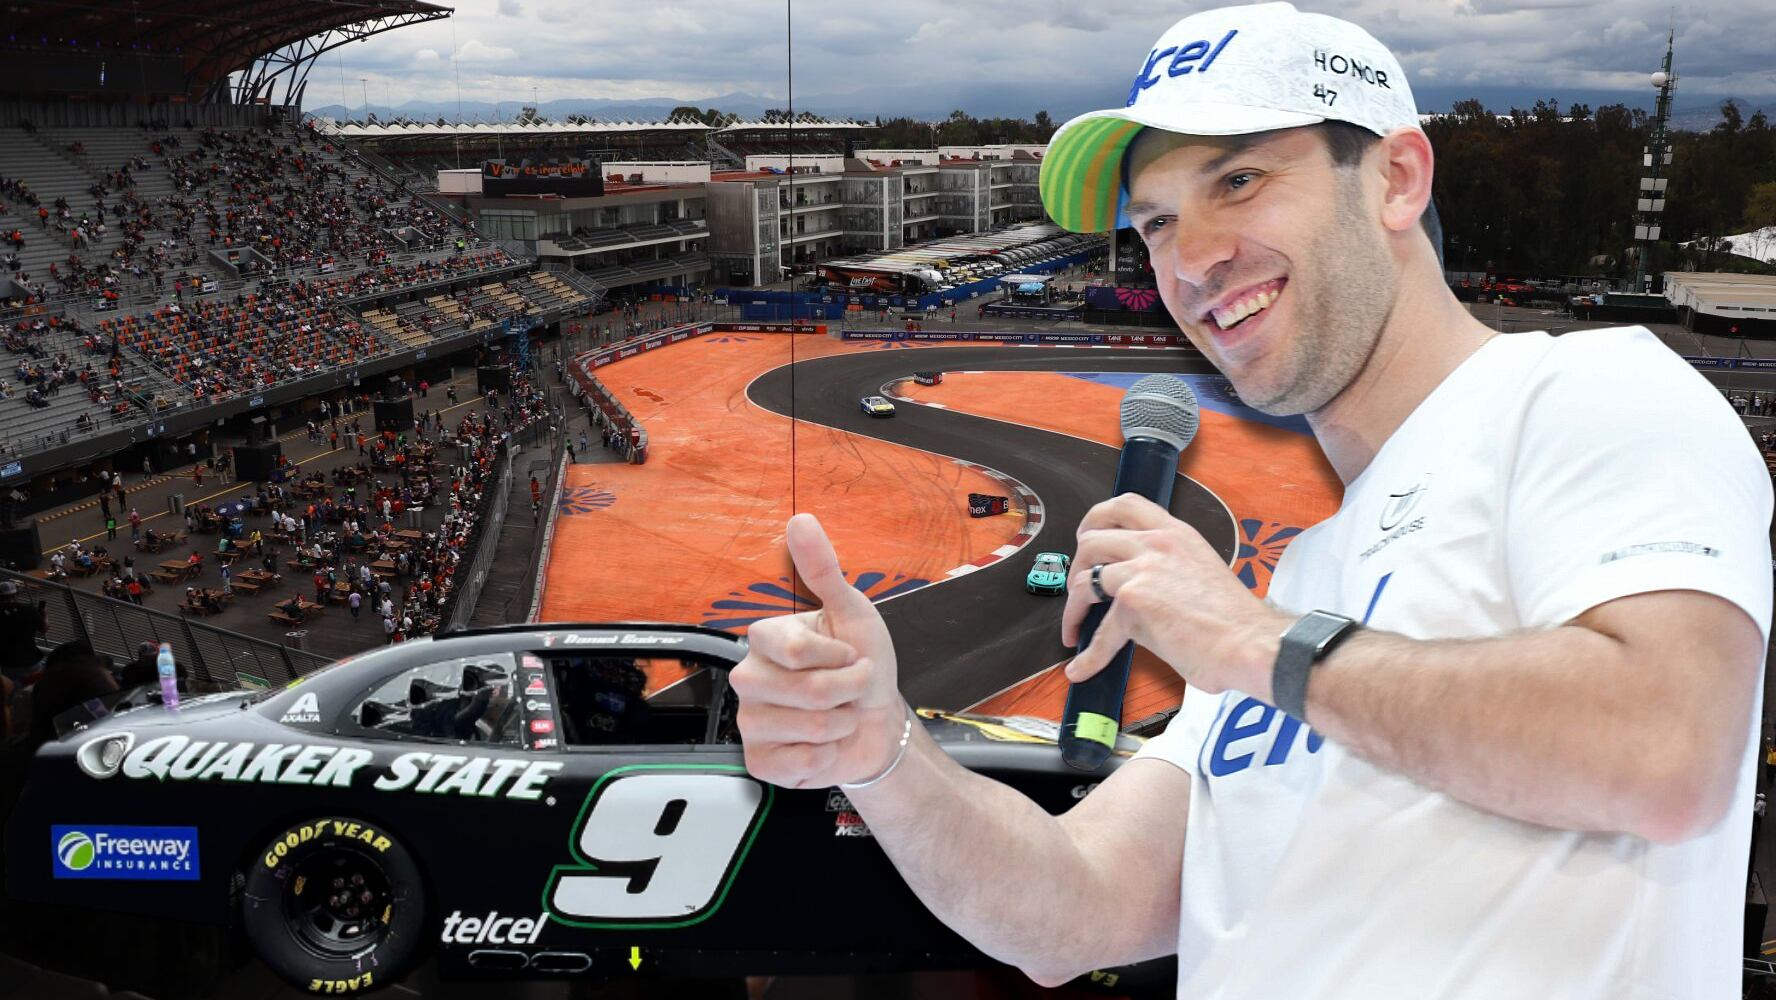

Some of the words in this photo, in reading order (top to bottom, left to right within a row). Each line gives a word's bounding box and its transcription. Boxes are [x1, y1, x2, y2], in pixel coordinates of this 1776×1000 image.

[1314, 50, 1391, 89] HONOR
[1313, 84, 1337, 106] 47
[122, 735, 374, 787] QUAKER
[373, 751, 565, 800] STATE
[95, 832, 192, 861] Freeway
[553, 773, 764, 919] 9
[97, 860, 191, 871] INSURANCE
[441, 910, 550, 944] telcel
[309, 971, 373, 993] EAGLE
